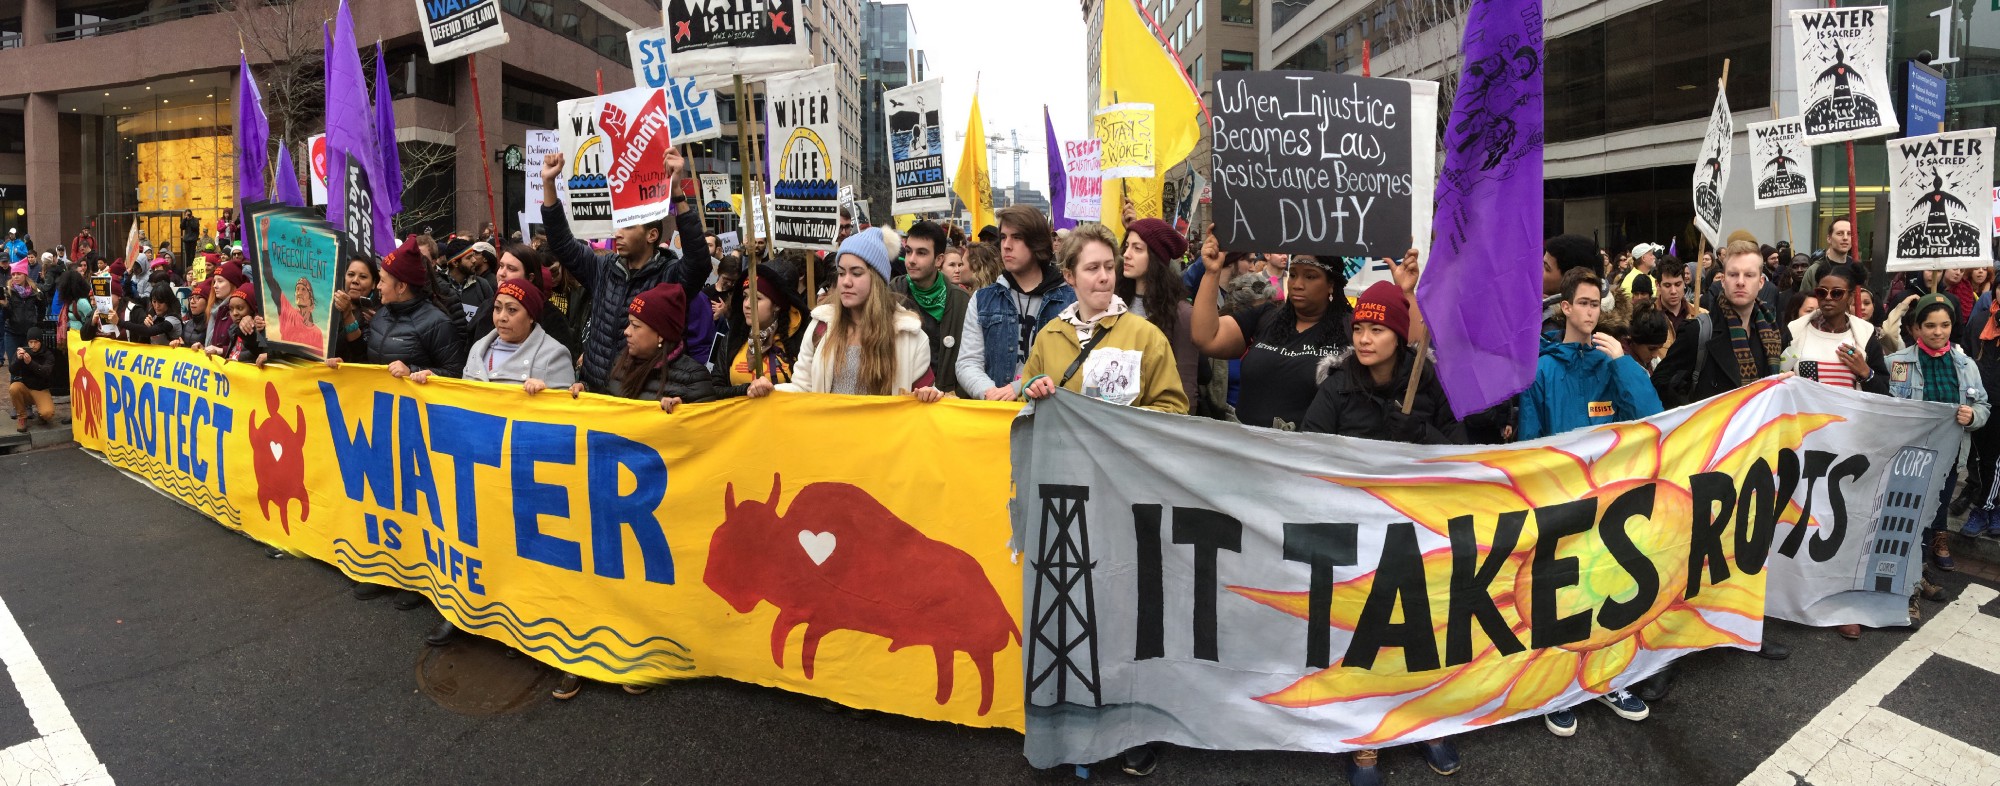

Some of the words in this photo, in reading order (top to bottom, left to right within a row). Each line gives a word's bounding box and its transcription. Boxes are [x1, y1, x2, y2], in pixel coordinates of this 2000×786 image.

[431, 20, 461, 41] DEFEND
[461, 14, 476, 30] THE
[703, 15, 719, 33] IS
[723, 13, 760, 31] LIFE
[1801, 9, 1874, 32] WATER
[1817, 30, 1825, 39] IS
[1827, 28, 1861, 38] SACRED
[1926, 5, 1960, 65] 1
[667, 80, 708, 111] IG
[1217, 79, 1283, 121] When
[1283, 76, 1396, 132] Injustice
[774, 95, 829, 128] WATER
[1100, 116, 1135, 145] STAY
[1756, 122, 1802, 139] WATER
[1810, 124, 1826, 133] NO
[1828, 117, 1879, 130] PIPELINES!
[536, 132, 550, 142] The
[798, 139, 804, 151] IS
[1211, 115, 1312, 157] Becomes
[1318, 122, 1386, 166] Law,
[608, 105, 668, 194] Solidarity
[1066, 139, 1101, 159] RESIST
[1107, 143, 1149, 164] WOKE!
[1900, 138, 1982, 160] WATER
[527, 158, 540, 166] Now
[789, 151, 818, 179] LIFE
[895, 158, 927, 173] PROTECT
[928, 155, 941, 168] THE
[1916, 159, 1924, 167] IS
[1927, 157, 1966, 166] SACRED
[896, 167, 942, 186] WATER
[1211, 153, 1330, 199] Resistance
[1333, 160, 1412, 198] Becomes
[638, 182, 666, 201] hate
[896, 187, 917, 199] DEFEND
[918, 186, 929, 196] THE
[929, 185, 945, 195] LAND
[1773, 187, 1806, 196] PIPELINES!
[348, 165, 361, 253] Water
[572, 203, 593, 217] MNÍ
[775, 219, 792, 235] MNÍ
[1229, 198, 1256, 244] A
[1901, 247, 1917, 256] NO
[1919, 246, 1977, 256] PIPELINES!
[1361, 302, 1386, 312] TAKES
[105, 348, 128, 371] WE
[130, 353, 166, 379] ARE
[171, 361, 211, 392] HERE
[214, 371, 230, 398] TO
[1589, 405, 1612, 413] RESIST
[104, 371, 234, 496] PROTECT
[1894, 449, 1932, 479] CORP.
[317, 380, 675, 585] WATER
[364, 512, 403, 551] IS
[422, 528, 486, 596] LIFE
[1131, 503, 1243, 663] IT
[1282, 482, 1660, 673] TAKES
[1877, 562, 1896, 574] CORP.
